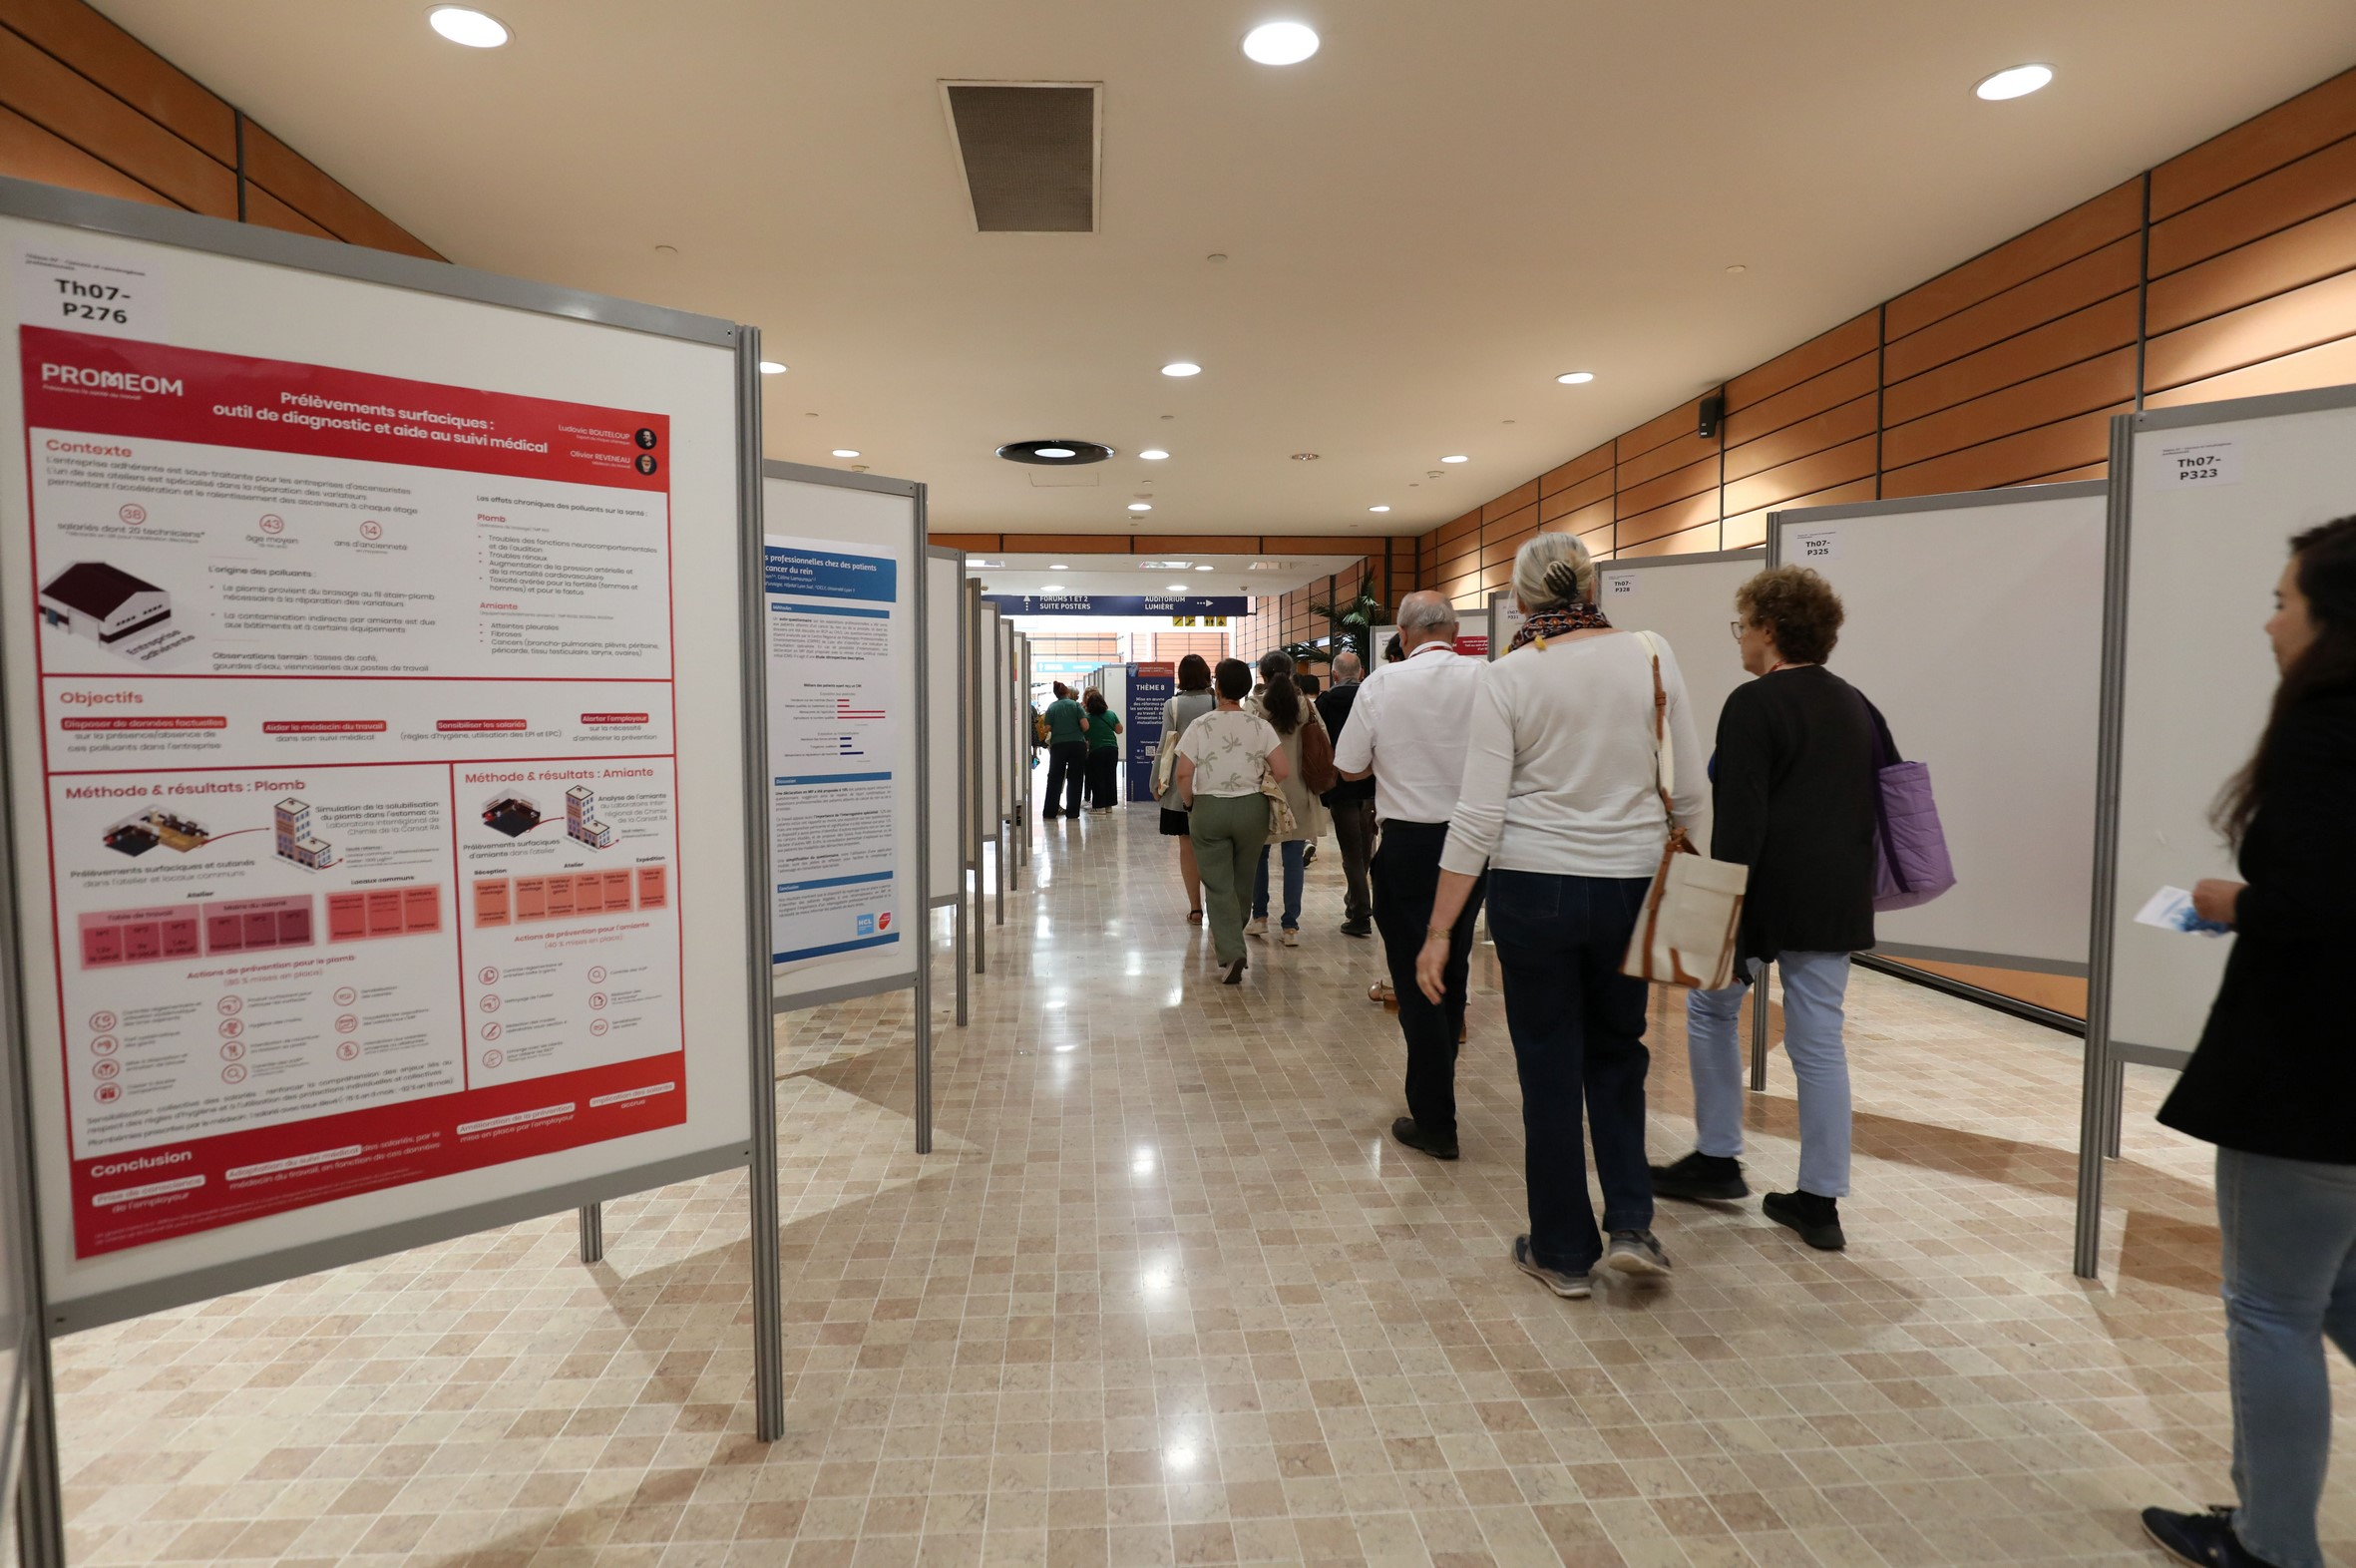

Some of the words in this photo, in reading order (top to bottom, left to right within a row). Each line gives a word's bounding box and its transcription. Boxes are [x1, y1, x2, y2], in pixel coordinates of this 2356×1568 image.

[54, 278, 131, 301] Th07-
[63, 302, 127, 324] P276
[41, 363, 183, 396] PROMEOM
[280, 391, 395, 417] Prélèvements
[398, 409, 487, 429] surfaciques
[212, 404, 252, 418] outil
[255, 407, 279, 421] de
[282, 410, 371, 432] diagnostic
[374, 423, 390, 434] et
[393, 424, 428, 438] aide
[430, 431, 451, 441] au
[453, 432, 487, 445] suivi
[490, 437, 547, 453] médical
[558, 424, 587, 434] Ludovic
[588, 428, 630, 439] BOUTELOUP
[46, 439, 132, 457] Contexte
[570, 450, 593, 459] Olivier
[594, 453, 630, 463] REVENEAU
[2177, 456, 2222, 468] Th07-
[2180, 469, 2218, 480] P323
[513, 499, 555, 508] chroniques
[122, 508, 143, 521] 38
[477, 513, 506, 522] Plomb
[262, 518, 281, 530] 43
[364, 525, 377, 535] 14
[245, 534, 264, 543] âge
[488, 534, 520, 543] Troubles
[536, 538, 570, 547] fonctions
[571, 542, 657, 553] neurocomportementales
[352, 541, 407, 550] d'ancienneté
[509, 544, 542, 552] l'audition
[489, 551, 520, 559] Troubles
[771, 555, 824, 566] professionnelles
[852, 563, 877, 571] patients
[60, 691, 143, 707] Objectifs
[62, 720, 111, 729] Disposer
[436, 721, 482, 730] Sensibiliser
[581, 715, 606, 723] Alerter
[264, 724, 290, 733] Aider
[465, 772, 524, 783] Méthode
[527, 771, 535, 781] &
[538, 770, 594, 780] résultats
[602, 768, 653, 777] Amiante
[65, 785, 147, 798] Méthode
[151, 784, 162, 795] &
[167, 782, 243, 795] résultats
[254, 780, 305, 791] Plomb
[90, 1151, 192, 1177] Conclusion
